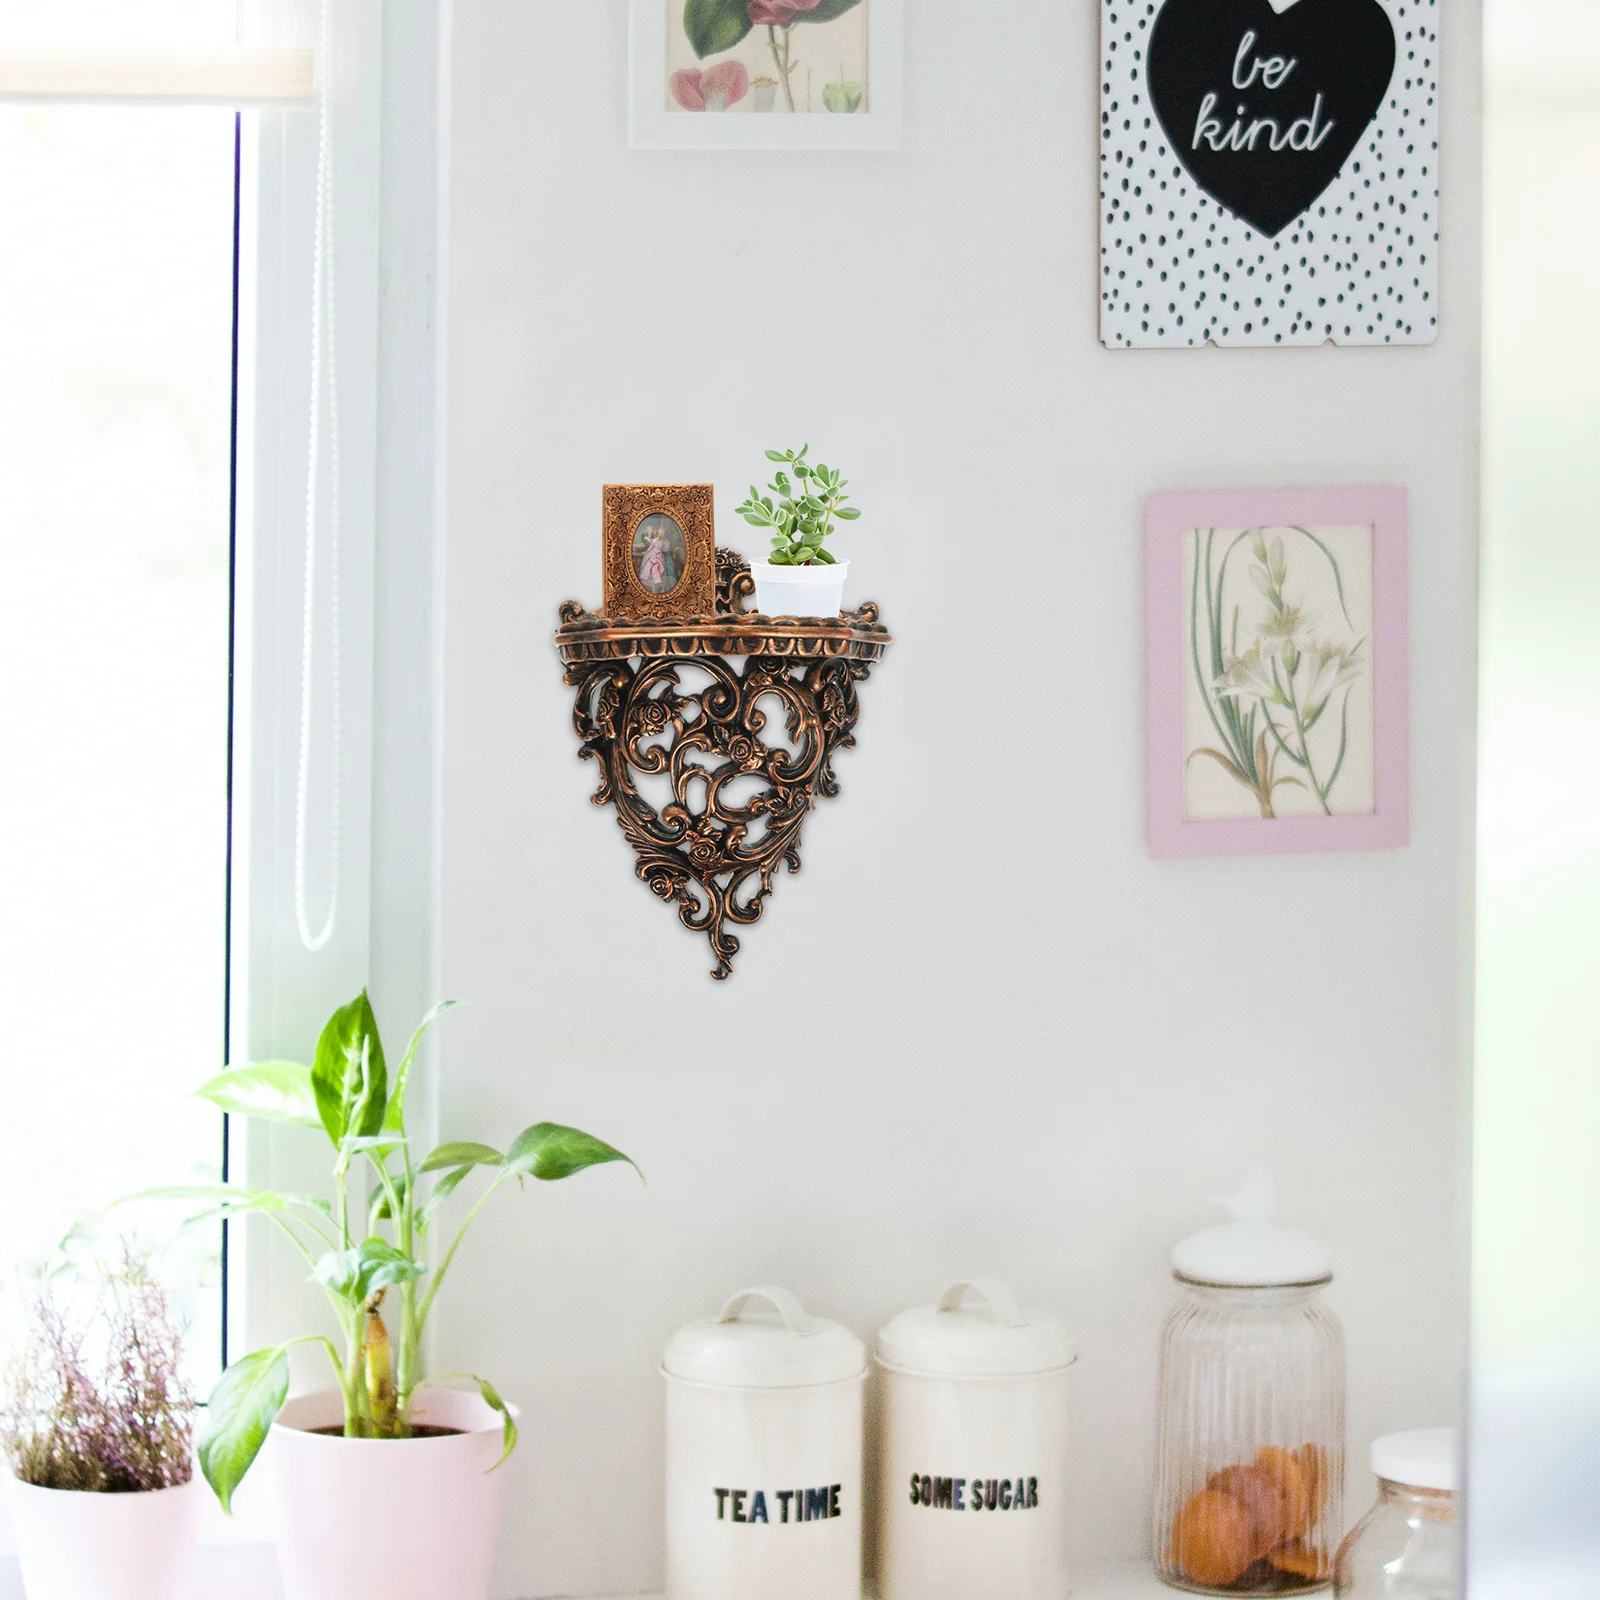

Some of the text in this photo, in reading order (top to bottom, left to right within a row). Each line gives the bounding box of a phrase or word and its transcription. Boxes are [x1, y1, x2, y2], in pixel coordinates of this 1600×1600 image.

[1231, 30, 1298, 90] be
[1190, 92, 1336, 152] kind
[713, 1483, 842, 1524] TEA TIME
[909, 1472, 1039, 1512] SOME SUGAR
